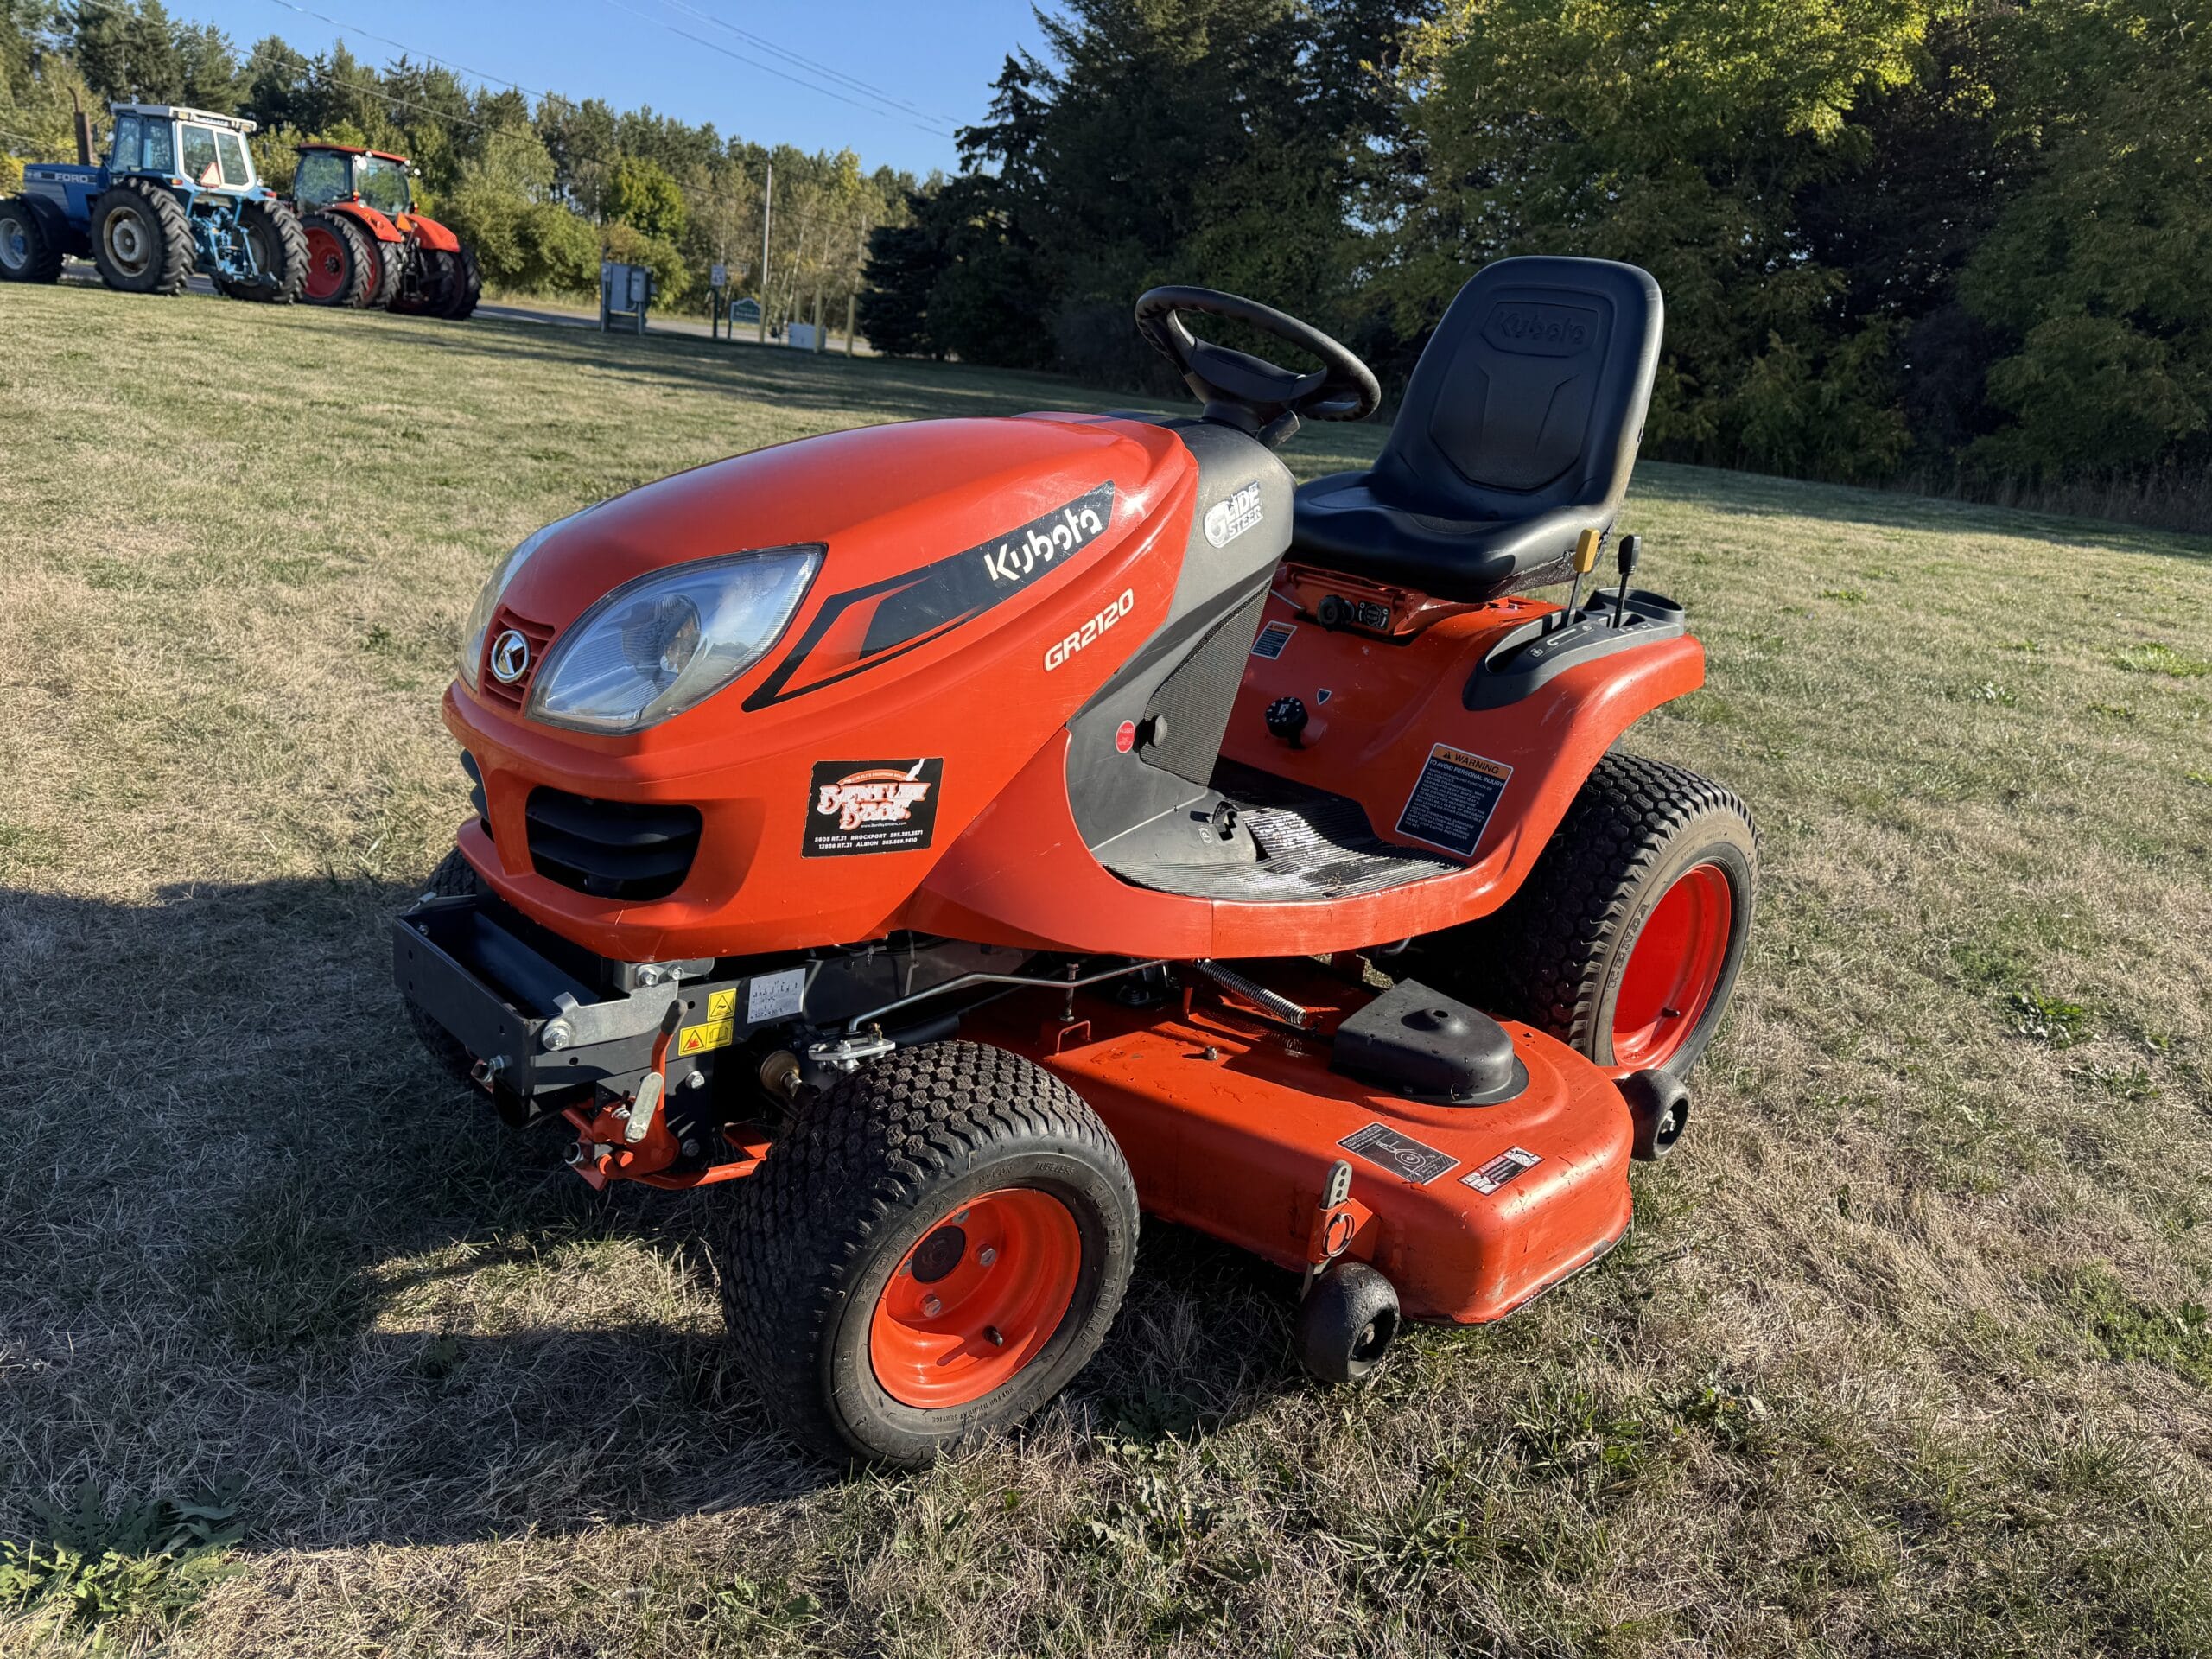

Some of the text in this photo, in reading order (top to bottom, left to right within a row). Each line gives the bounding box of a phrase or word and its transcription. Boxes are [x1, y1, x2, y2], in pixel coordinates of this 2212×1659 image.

[54, 173, 88, 183] FORD
[1499, 311, 1588, 345] Kubota
[1228, 505, 1262, 537] STEER
[983, 507, 1103, 582] Kubota
[1043, 588, 1135, 672] GR2120
[1436, 761, 1453, 770] AVOID
[1453, 766, 1482, 780] PERSONAL
[1483, 777, 1503, 786] INJURY
[1454, 753, 1500, 774] WARNING
[1605, 902, 1650, 992] KENDA
[1034, 1160, 1076, 1176] TUBELESS
[1085, 1181, 1122, 1255] SUPER
[853, 1192, 952, 1304] KENDA
[1077, 1275, 1120, 1351] TURF
[931, 1413, 958, 1424] SERVICE
